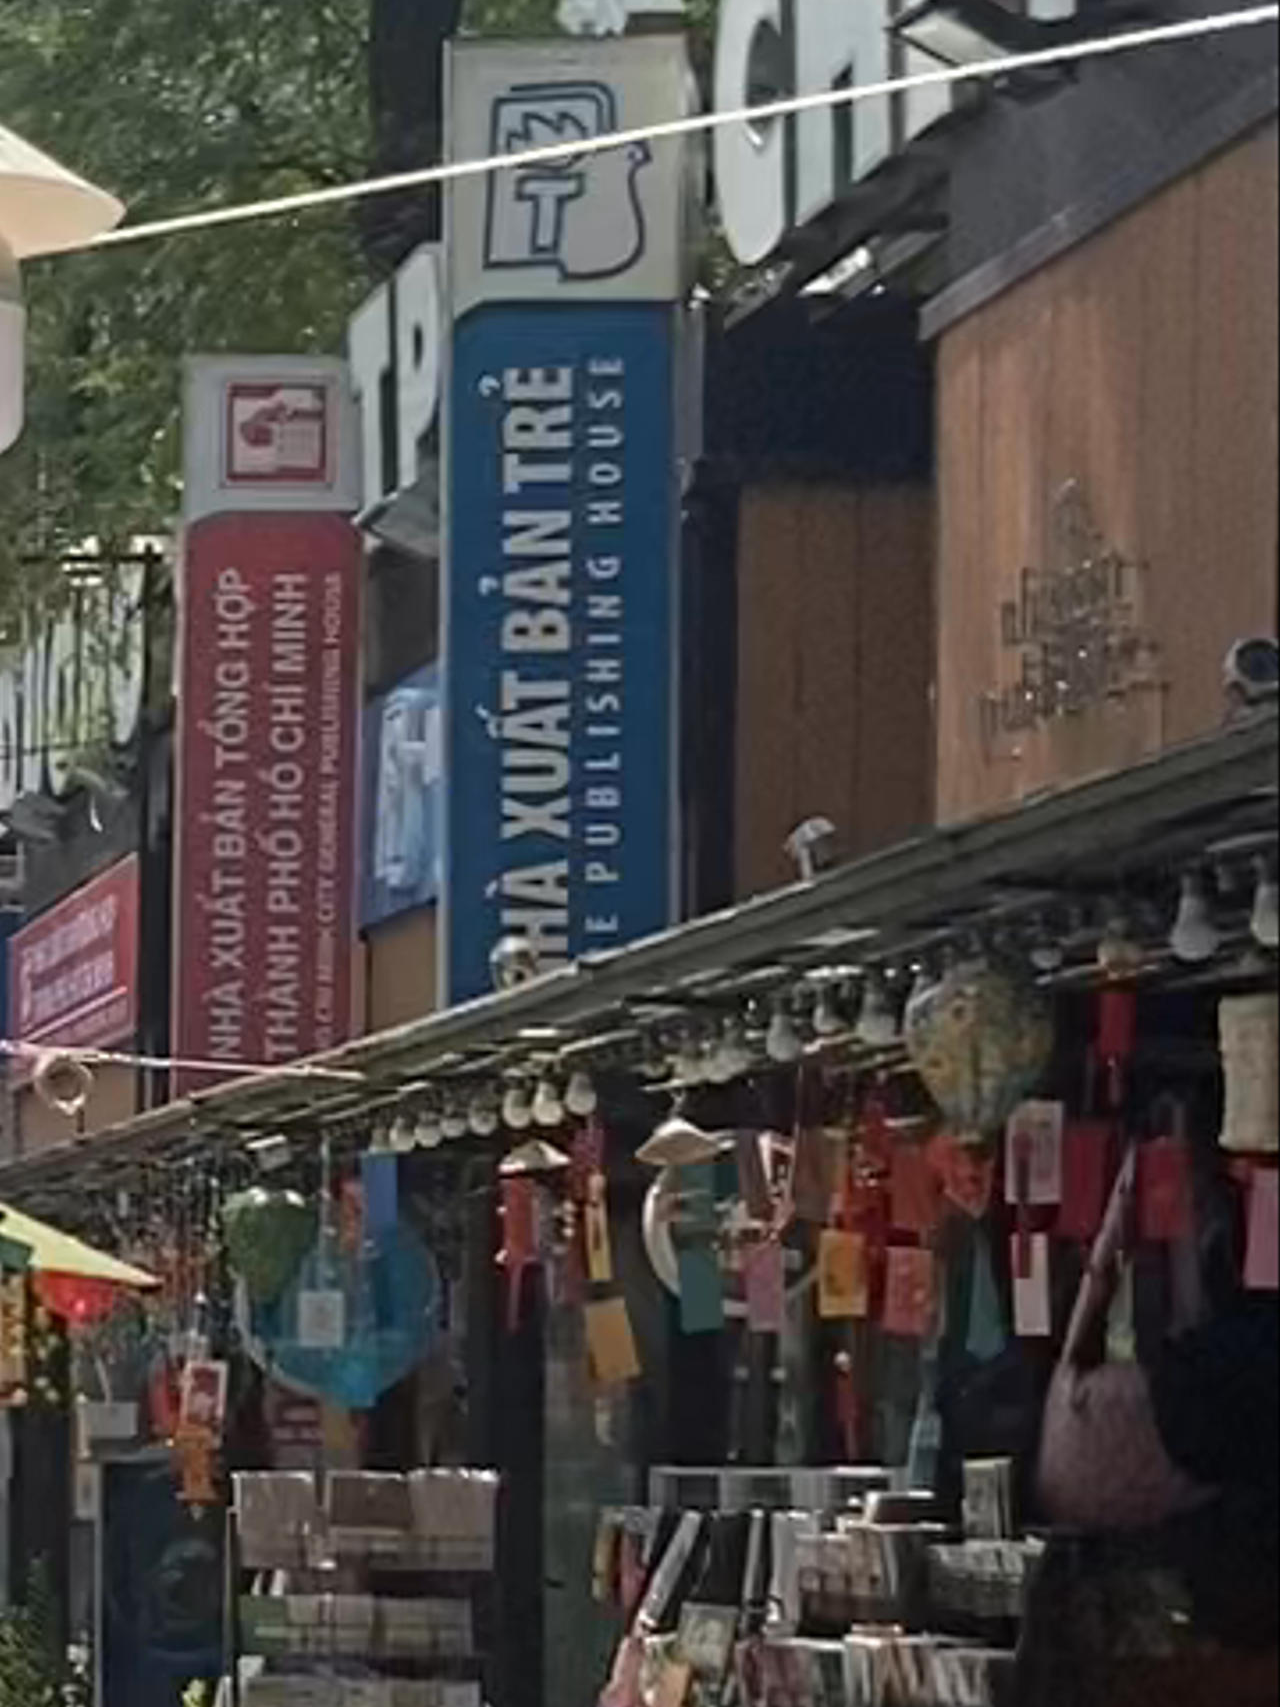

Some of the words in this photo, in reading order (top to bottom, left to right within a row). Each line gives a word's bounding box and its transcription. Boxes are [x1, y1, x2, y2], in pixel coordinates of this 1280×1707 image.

[477, 366, 572, 493] TRẺ
[588, 357, 624, 524] HOUSE
[216, 566, 255, 651] HỢP
[271, 572, 308, 672] MINH
[477, 510, 572, 652] BẢN
[199, 661, 250, 767] TỔNG
[267, 683, 306, 752] CHÍ
[476, 670, 571, 839] XUẤT
[585, 555, 622, 883] PUBLISHING
[202, 780, 247, 859] BẢN
[256, 828, 304, 913] PHỐ
[197, 870, 247, 969] XUẤT
[204, 980, 244, 1060] NHÀ
[258, 925, 301, 1060] THÀNH
